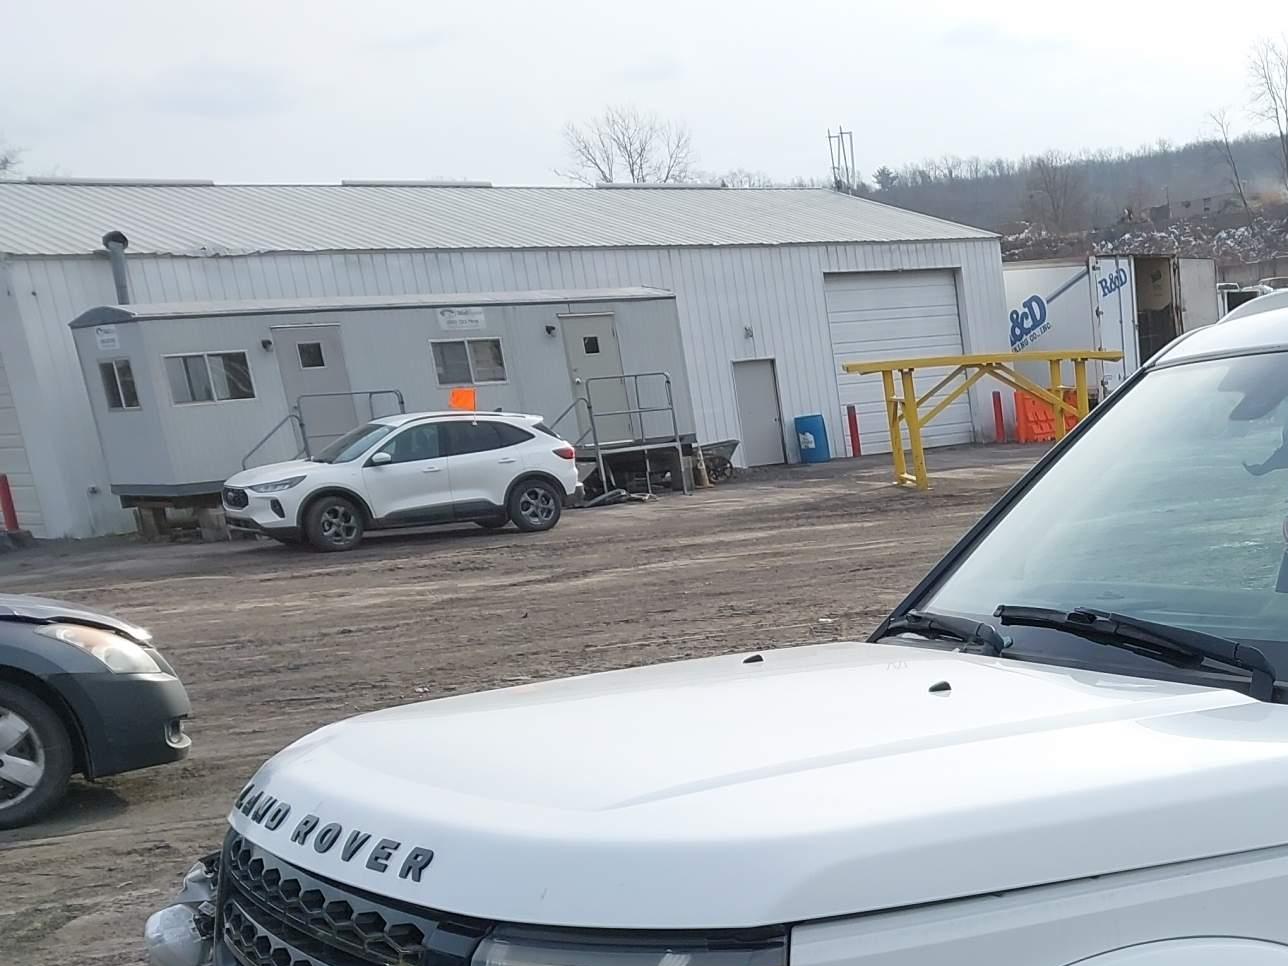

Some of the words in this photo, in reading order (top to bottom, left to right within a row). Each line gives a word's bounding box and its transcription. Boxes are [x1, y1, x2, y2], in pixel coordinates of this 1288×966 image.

[1098, 268, 1128, 297] R&D
[235, 783, 291, 831] LAND
[290, 814, 434, 882] ROVER
